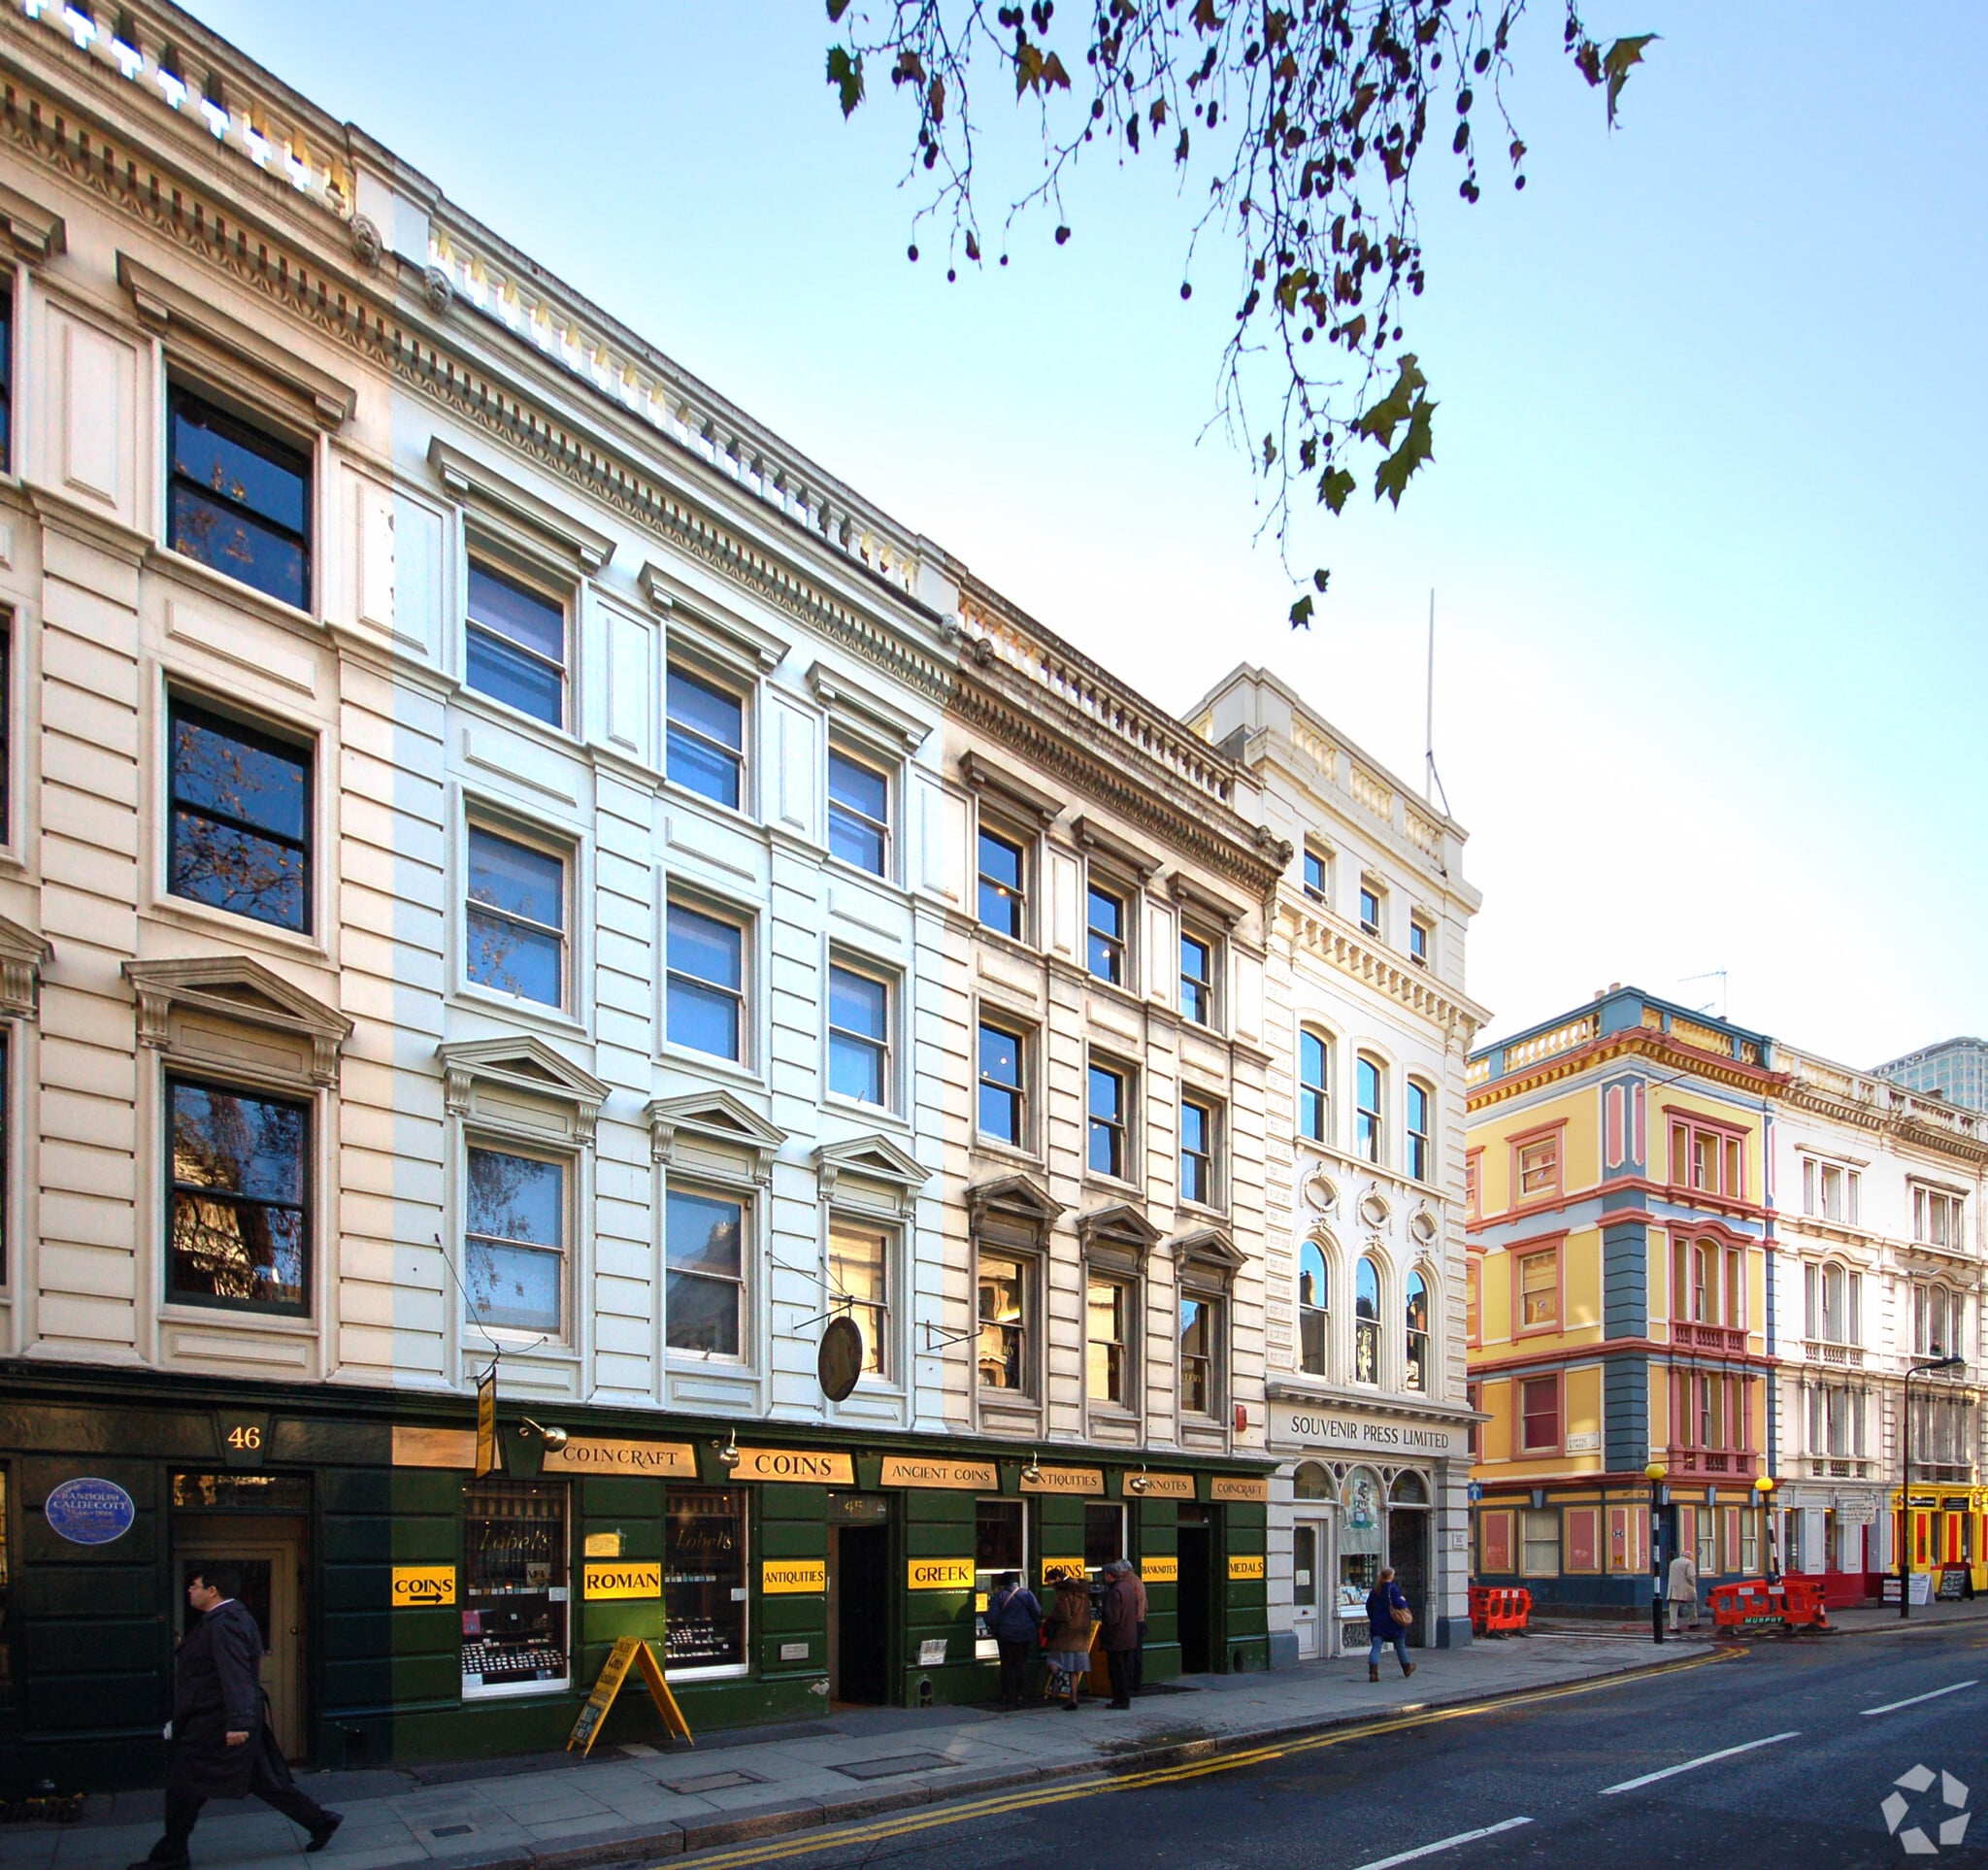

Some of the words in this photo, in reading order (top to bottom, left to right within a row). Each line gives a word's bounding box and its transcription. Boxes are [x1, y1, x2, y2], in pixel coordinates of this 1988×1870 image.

[227, 1426, 260, 1449] 46
[1291, 1416, 1357, 1439] SOUVENIR
[1363, 1424, 1399, 1444] PRESS
[1403, 1429, 1449, 1449] LIMITED
[563, 1446, 678, 1469] COINCRAFT
[754, 1454, 832, 1476] COINS
[892, 1465, 948, 1479] ANCIENT
[954, 1469, 990, 1482] COINS
[1039, 1473, 1098, 1486] NTIQUITIES
[1217, 1483, 1262, 1497] COINCRAFT
[53, 1500, 125, 1510] CALDECOTT
[914, 1565, 969, 1583] GREEK
[1142, 1564, 1177, 1575] BANKNOTES
[1230, 1561, 1263, 1573] MEDALS
[586, 1572, 659, 1589] ROMAN
[764, 1570, 824, 1584] ANTIQUITIES
[394, 1579, 453, 1593] COINS
[1744, 1616, 1782, 1624] MURPHY
